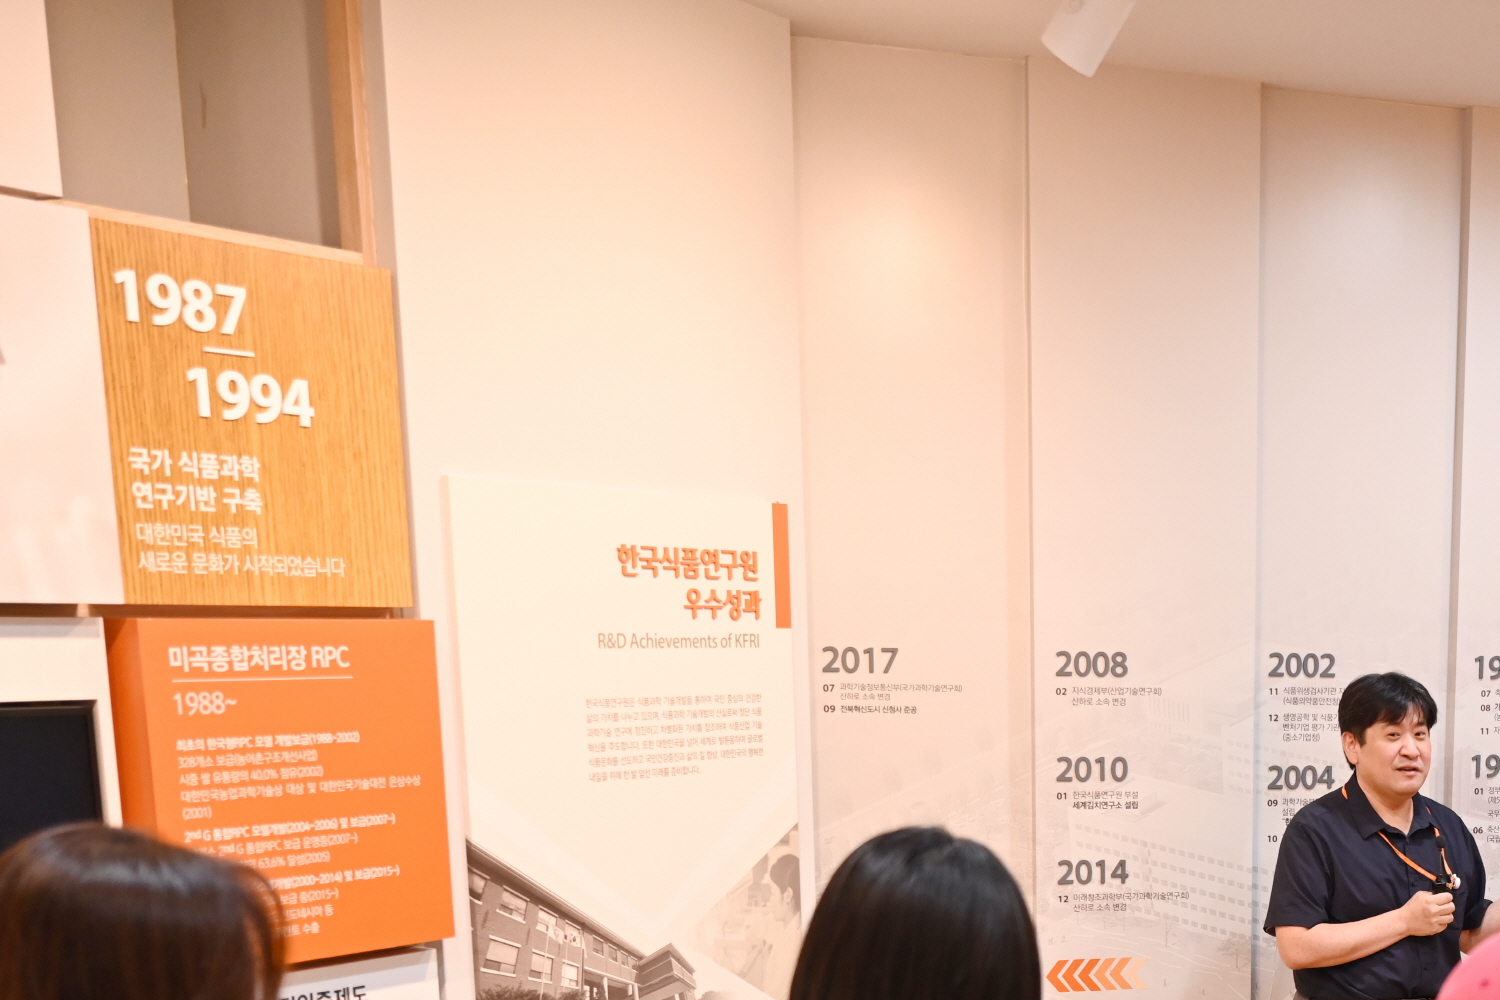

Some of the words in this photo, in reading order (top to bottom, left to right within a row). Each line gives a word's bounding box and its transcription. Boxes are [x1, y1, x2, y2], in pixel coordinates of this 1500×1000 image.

[113, 268, 247, 336] 1987
[186, 366, 315, 428] 1994
[128, 446, 173, 476] 국가
[178, 450, 261, 482] 식품과학
[131, 481, 217, 512] 연구기반
[222, 487, 263, 515] 구축
[136, 523, 205, 546] 대한민국
[209, 526, 259, 549] 식품의
[138, 551, 188, 575] 새로운
[192, 553, 240, 576] 문화가
[243, 555, 345, 578] 시작되었습니다
[616, 543, 760, 582] 한국식품연구원
[683, 587, 763, 622] 우수성과
[597, 633, 627, 649] R&D
[630, 632, 718, 649] Achievements
[720, 632, 733, 649] of
[735, 633, 760, 649] KFRI
[168, 645, 307, 673] 미곡종합처리장
[311, 645, 351, 669] RPC
[821, 646, 899, 674] 2017
[1055, 650, 1129, 678] 2008
[1267, 652, 1336, 679] 2002
[822, 684, 835, 692] 07
[1055, 687, 1068, 696] 02
[1269, 688, 1279, 696] 11
[840, 693, 861, 701] 산하로
[877, 693, 891, 701] 변경
[1481, 690, 1491, 698] 07
[173, 691, 238, 717] 1988~
[1072, 697, 1094, 706] 산하로
[1112, 698, 1127, 707] 변경
[823, 705, 836, 713] 09
[840, 705, 881, 714] 전북혁신도시
[903, 706, 918, 714] 준공
[1480, 704, 1491, 712] 08
[1268, 714, 1279, 722] 12
[1311, 723, 1325, 732] 평가
[1480, 727, 1490, 735] 11
[1055, 756, 1129, 783] 2010
[1267, 765, 1335, 790] 2004
[1056, 792, 1068, 800] 01
[1072, 790, 1122, 800] 한국식품연구원
[1474, 787, 1484, 795] 01
[1072, 801, 1122, 810] 세계김치연구소
[1124, 801, 1139, 810] 설립
[1267, 799, 1279, 807] 09
[1473, 826, 1484, 834] 06
[1267, 834, 1278, 843] 10
[1057, 859, 1129, 886] 2014
[1058, 895, 1069, 903] 12
[1073, 903, 1095, 913] 산하로
[1113, 903, 1127, 912] 변경
